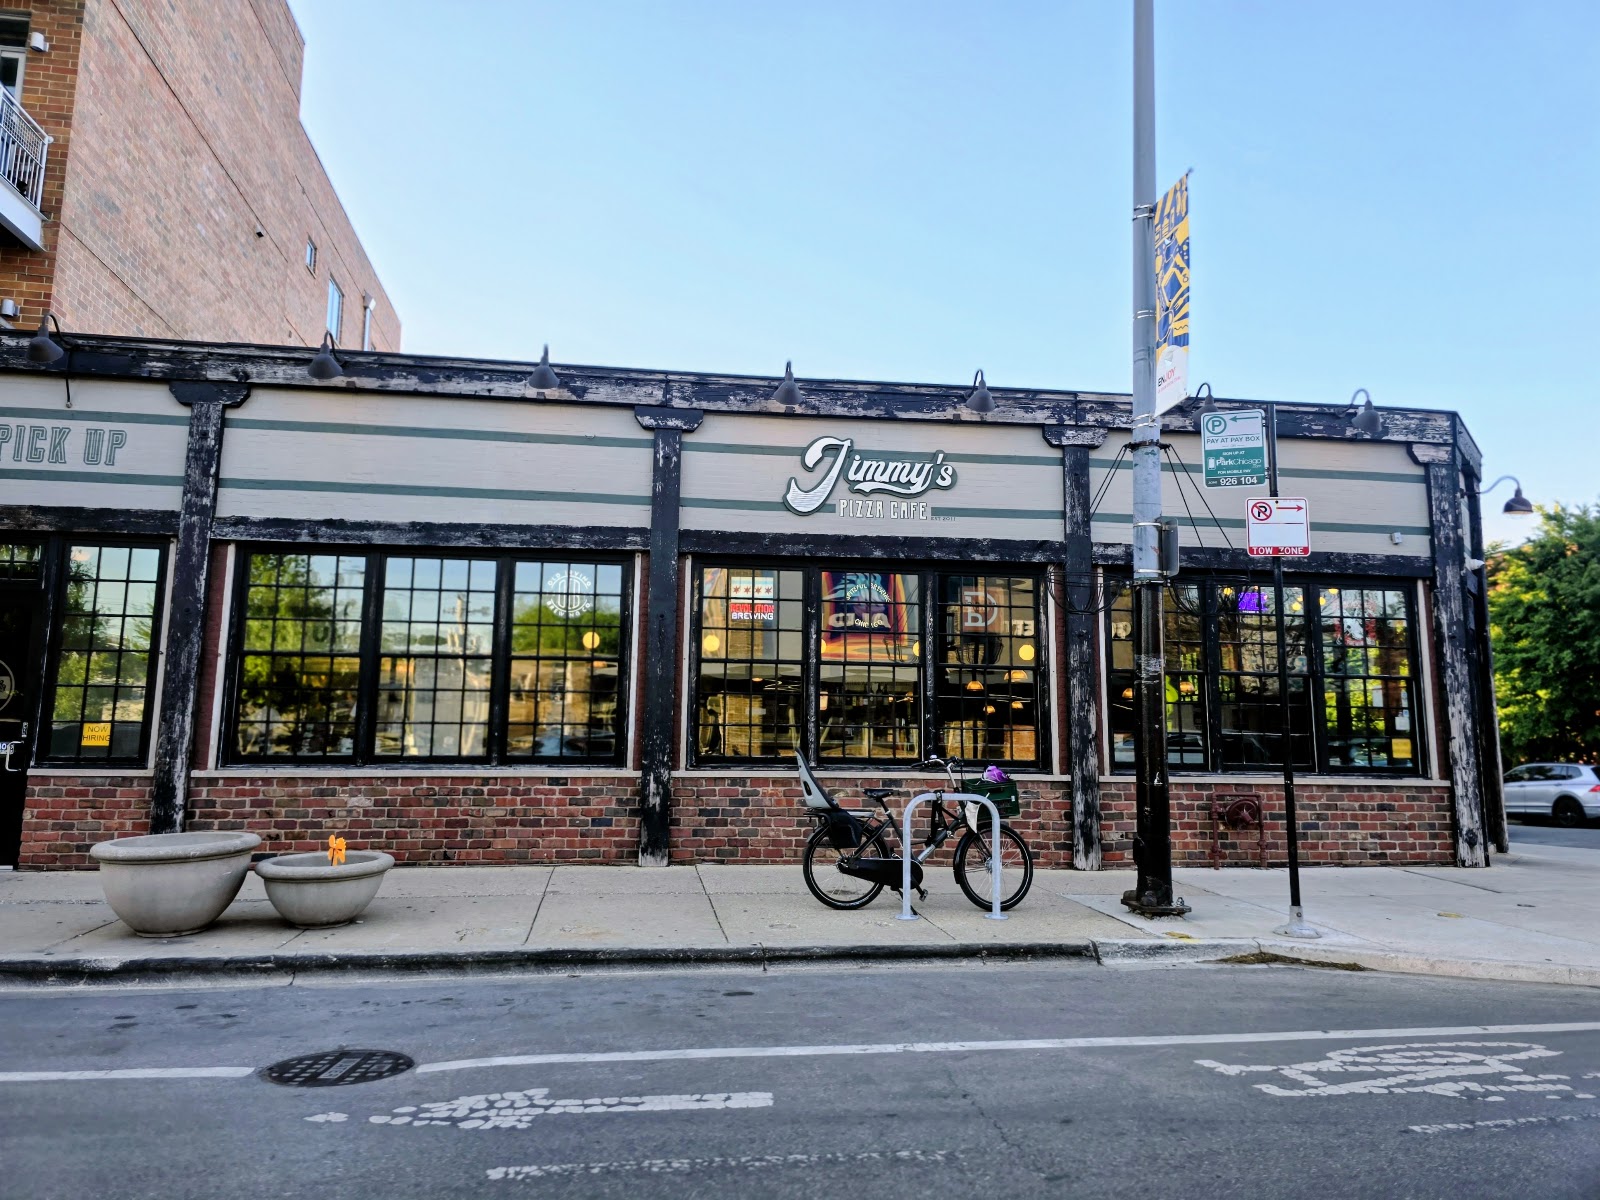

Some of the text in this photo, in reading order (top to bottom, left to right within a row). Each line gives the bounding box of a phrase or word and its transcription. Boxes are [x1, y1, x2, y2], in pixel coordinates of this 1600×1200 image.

[0, 424, 127, 466] PICK UP
[785, 437, 955, 514] Jimmy's
[839, 499, 927, 520] PIZZA CAFE
[1252, 547, 1305, 555] TOW ZONE
[546, 600, 581, 618] BREWNG
[731, 612, 774, 620] BREWING
[87, 725, 108, 733] NOW
